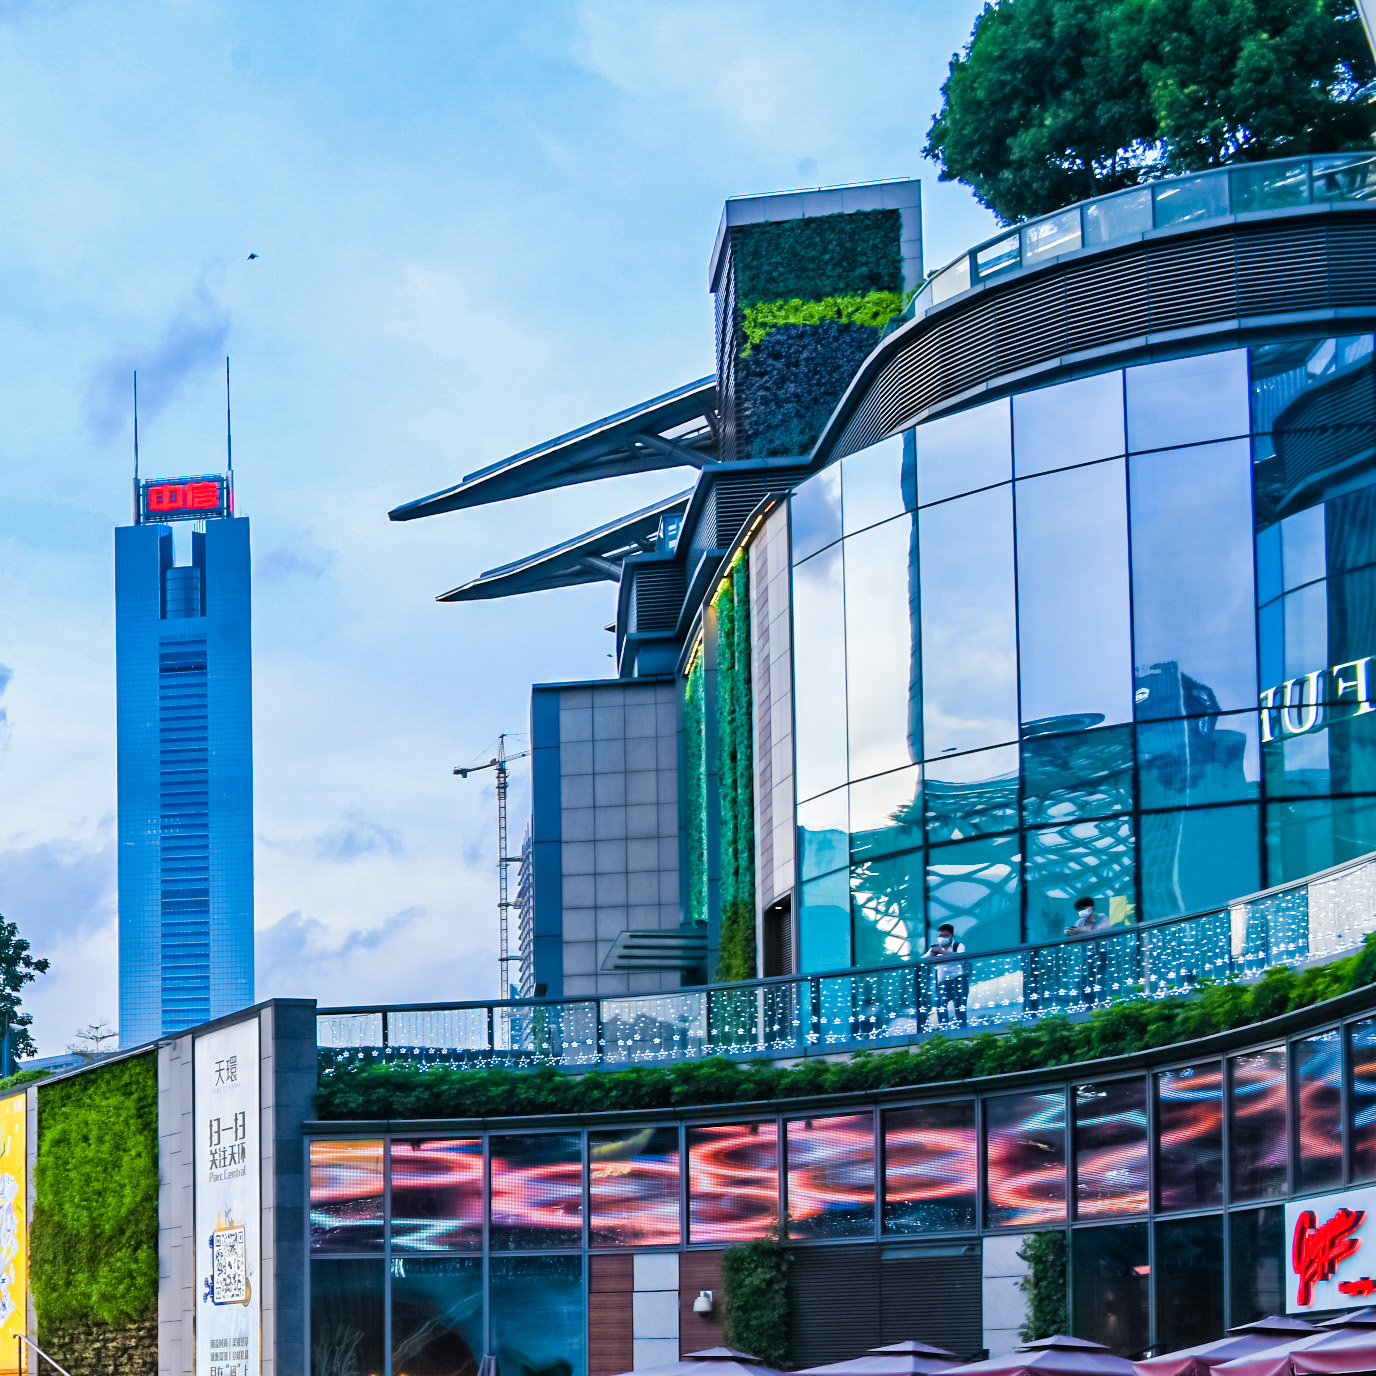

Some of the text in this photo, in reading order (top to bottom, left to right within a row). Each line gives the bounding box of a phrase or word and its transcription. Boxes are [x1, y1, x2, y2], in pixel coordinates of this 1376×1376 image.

[148, 481, 219, 512] 中信
[209, 1111, 246, 1147] 扫一扫
[209, 1142, 246, 1170] 关注天环
[209, 1165, 246, 1182] Parc Central
